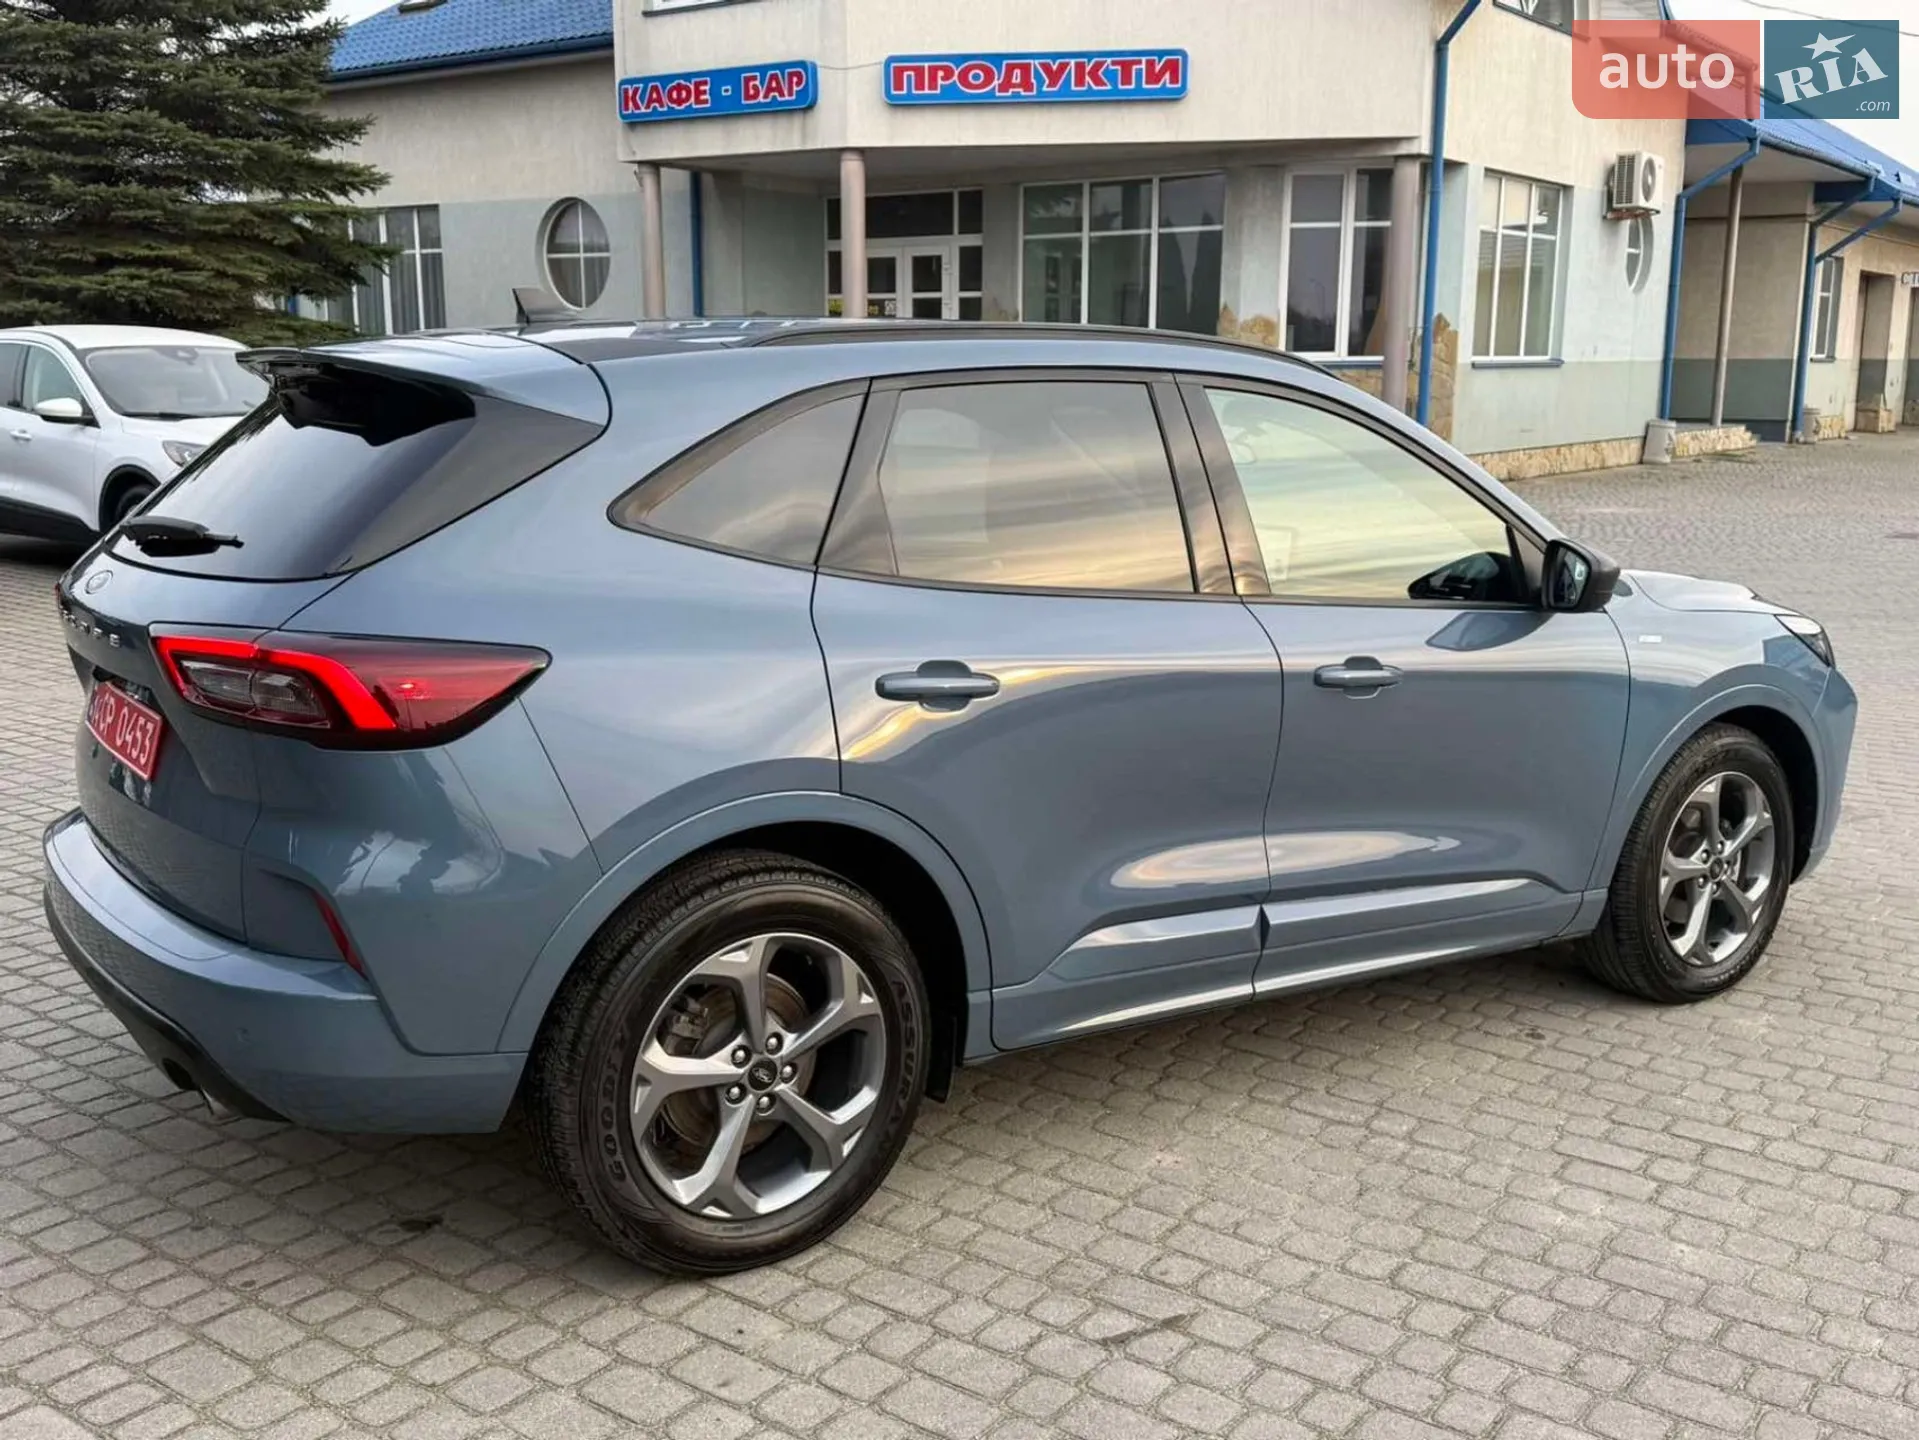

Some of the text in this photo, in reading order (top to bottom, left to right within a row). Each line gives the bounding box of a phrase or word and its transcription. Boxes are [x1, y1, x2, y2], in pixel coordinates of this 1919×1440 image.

[621, 77, 711, 114] КАФЕ
[740, 67, 808, 103] БАР
[889, 56, 1183, 96] ПРОДУКТИ
[116, 706, 155, 766] 0453
